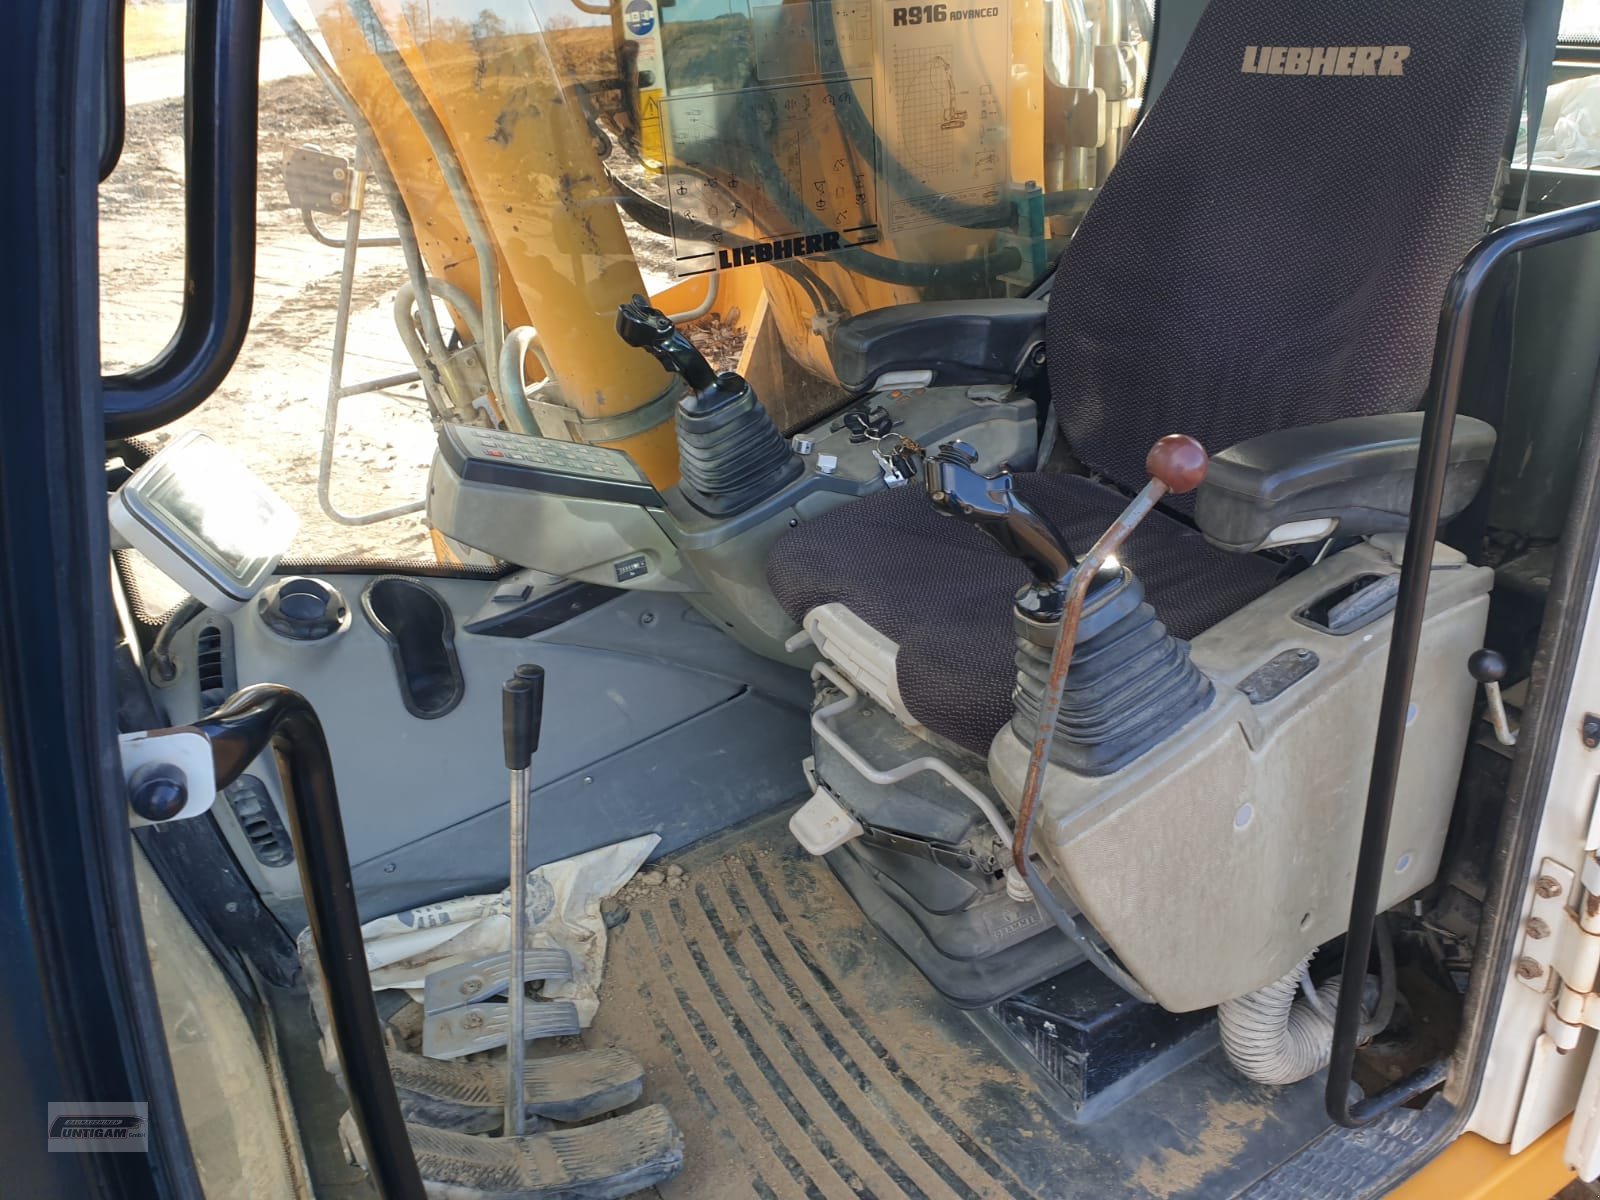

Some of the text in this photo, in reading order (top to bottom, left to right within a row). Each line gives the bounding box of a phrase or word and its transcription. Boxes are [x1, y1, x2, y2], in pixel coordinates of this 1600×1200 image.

[893, 4, 999, 27] R916 ADVANCED
[1241, 45, 1412, 77] LIEBHERR
[718, 231, 841, 270] LIEBHERR
